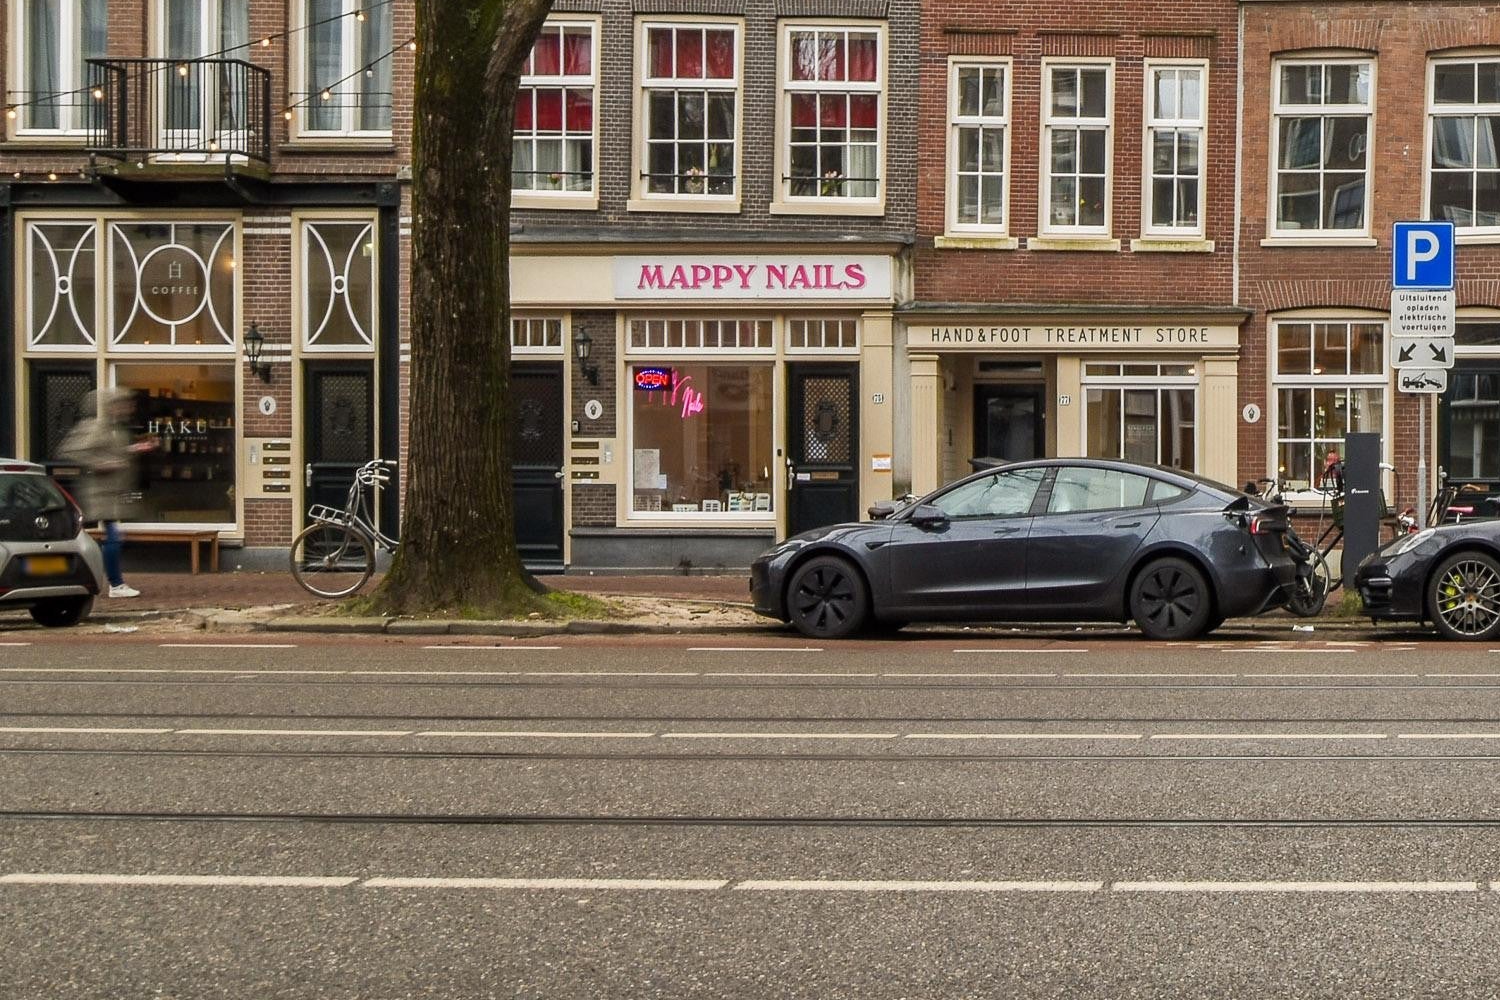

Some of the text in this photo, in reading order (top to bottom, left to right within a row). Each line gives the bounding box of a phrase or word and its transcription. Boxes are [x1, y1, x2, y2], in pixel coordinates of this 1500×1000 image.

[1407, 231, 1440, 280] P
[637, 264, 867, 290] MAPPY NAILS
[152, 287, 199, 295] COFFEE
[1402, 324, 1447, 332] voertuigen
[931, 328, 1209, 343] HAND&FOOT TREATMENT STORE
[636, 374, 669, 386] OPEN
[149, 421, 207, 434] HAKU
